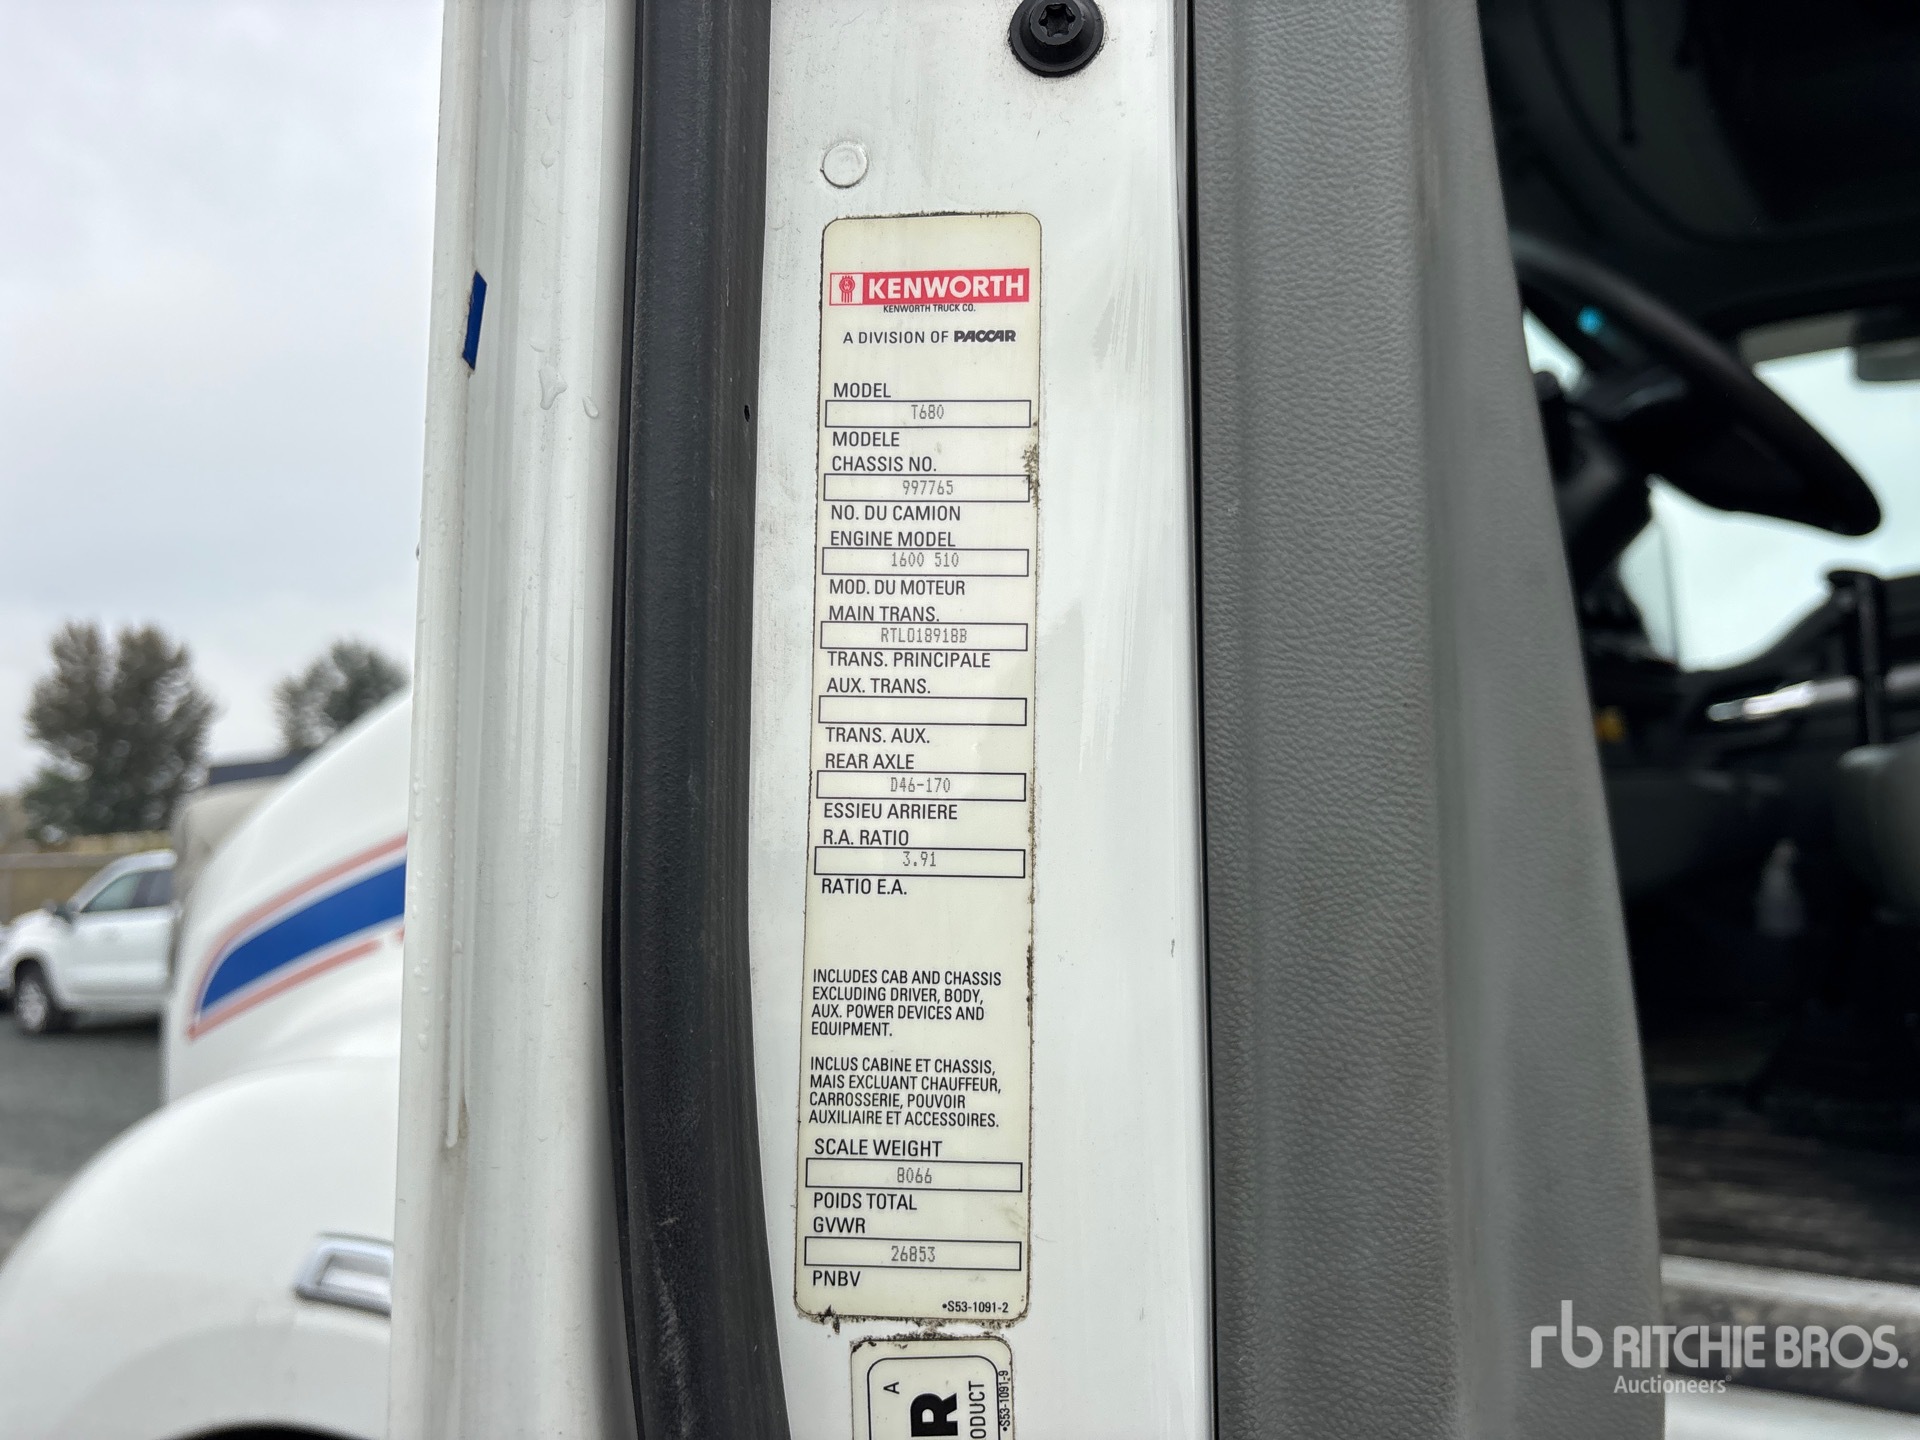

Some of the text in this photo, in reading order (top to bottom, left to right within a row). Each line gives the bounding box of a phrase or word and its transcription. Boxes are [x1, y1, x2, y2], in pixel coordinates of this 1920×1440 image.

[869, 275, 1025, 300] KENWORTH
[883, 303, 976, 313] KENWORTH TRUCK CO.
[843, 330, 1016, 344] A DIVISION OF PACCAR
[833, 383, 891, 398] MODEL
[911, 405, 944, 419] T680
[832, 432, 900, 447] MODELE
[832, 456, 937, 471] CHASSIS NO.
[902, 480, 953, 495] 997765
[831, 505, 961, 521] NO. DU CAMION
[830, 531, 956, 547] ENGINE MODEL
[891, 552, 959, 567] 1600 510
[829, 579, 965, 595] MOD. DU MOTEUR
[829, 605, 939, 622] MAIN TRANS.
[827, 651, 991, 668] TRANS. PRINCIPALE
[827, 678, 931, 693] AUX. TRANS.
[825, 727, 930, 743] TRANS. AUX.
[825, 753, 914, 769] REAR AXLE
[890, 777, 951, 793] D46-170
[824, 803, 958, 819] ESSIEU ARRIERE
[823, 829, 909, 846] R.A. RATIO
[902, 851, 936, 867] 3.91
[822, 878, 907, 895] RATIO E.A.
[813, 969, 1002, 986] INCLUDES CAB AND CHASSIS
[812, 986, 983, 1005] EXCLUDING DRIVER, BODY,
[811, 1004, 985, 1021] AUX. POWER DEVICES AND
[811, 1021, 892, 1037] EQUIPMENT.
[810, 1056, 996, 1075] INCLUS CABINE ET CHASSIS,
[810, 1074, 1002, 1094] MAIS EXCLUANT CHAUFFEUR,
[809, 1092, 966, 1109] CARROSSERIE, POUVOIR
[809, 1110, 999, 1127] AUXILIAIRE ET ACCESSOIRES.
[814, 1138, 943, 1157] SCALE WEIGHT
[897, 1167, 932, 1184] 8066
[813, 1192, 917, 1210] POIDS TOTAL
[813, 1217, 866, 1233] GVWR
[891, 1246, 936, 1262] 26853
[812, 1270, 861, 1287] PNBV
